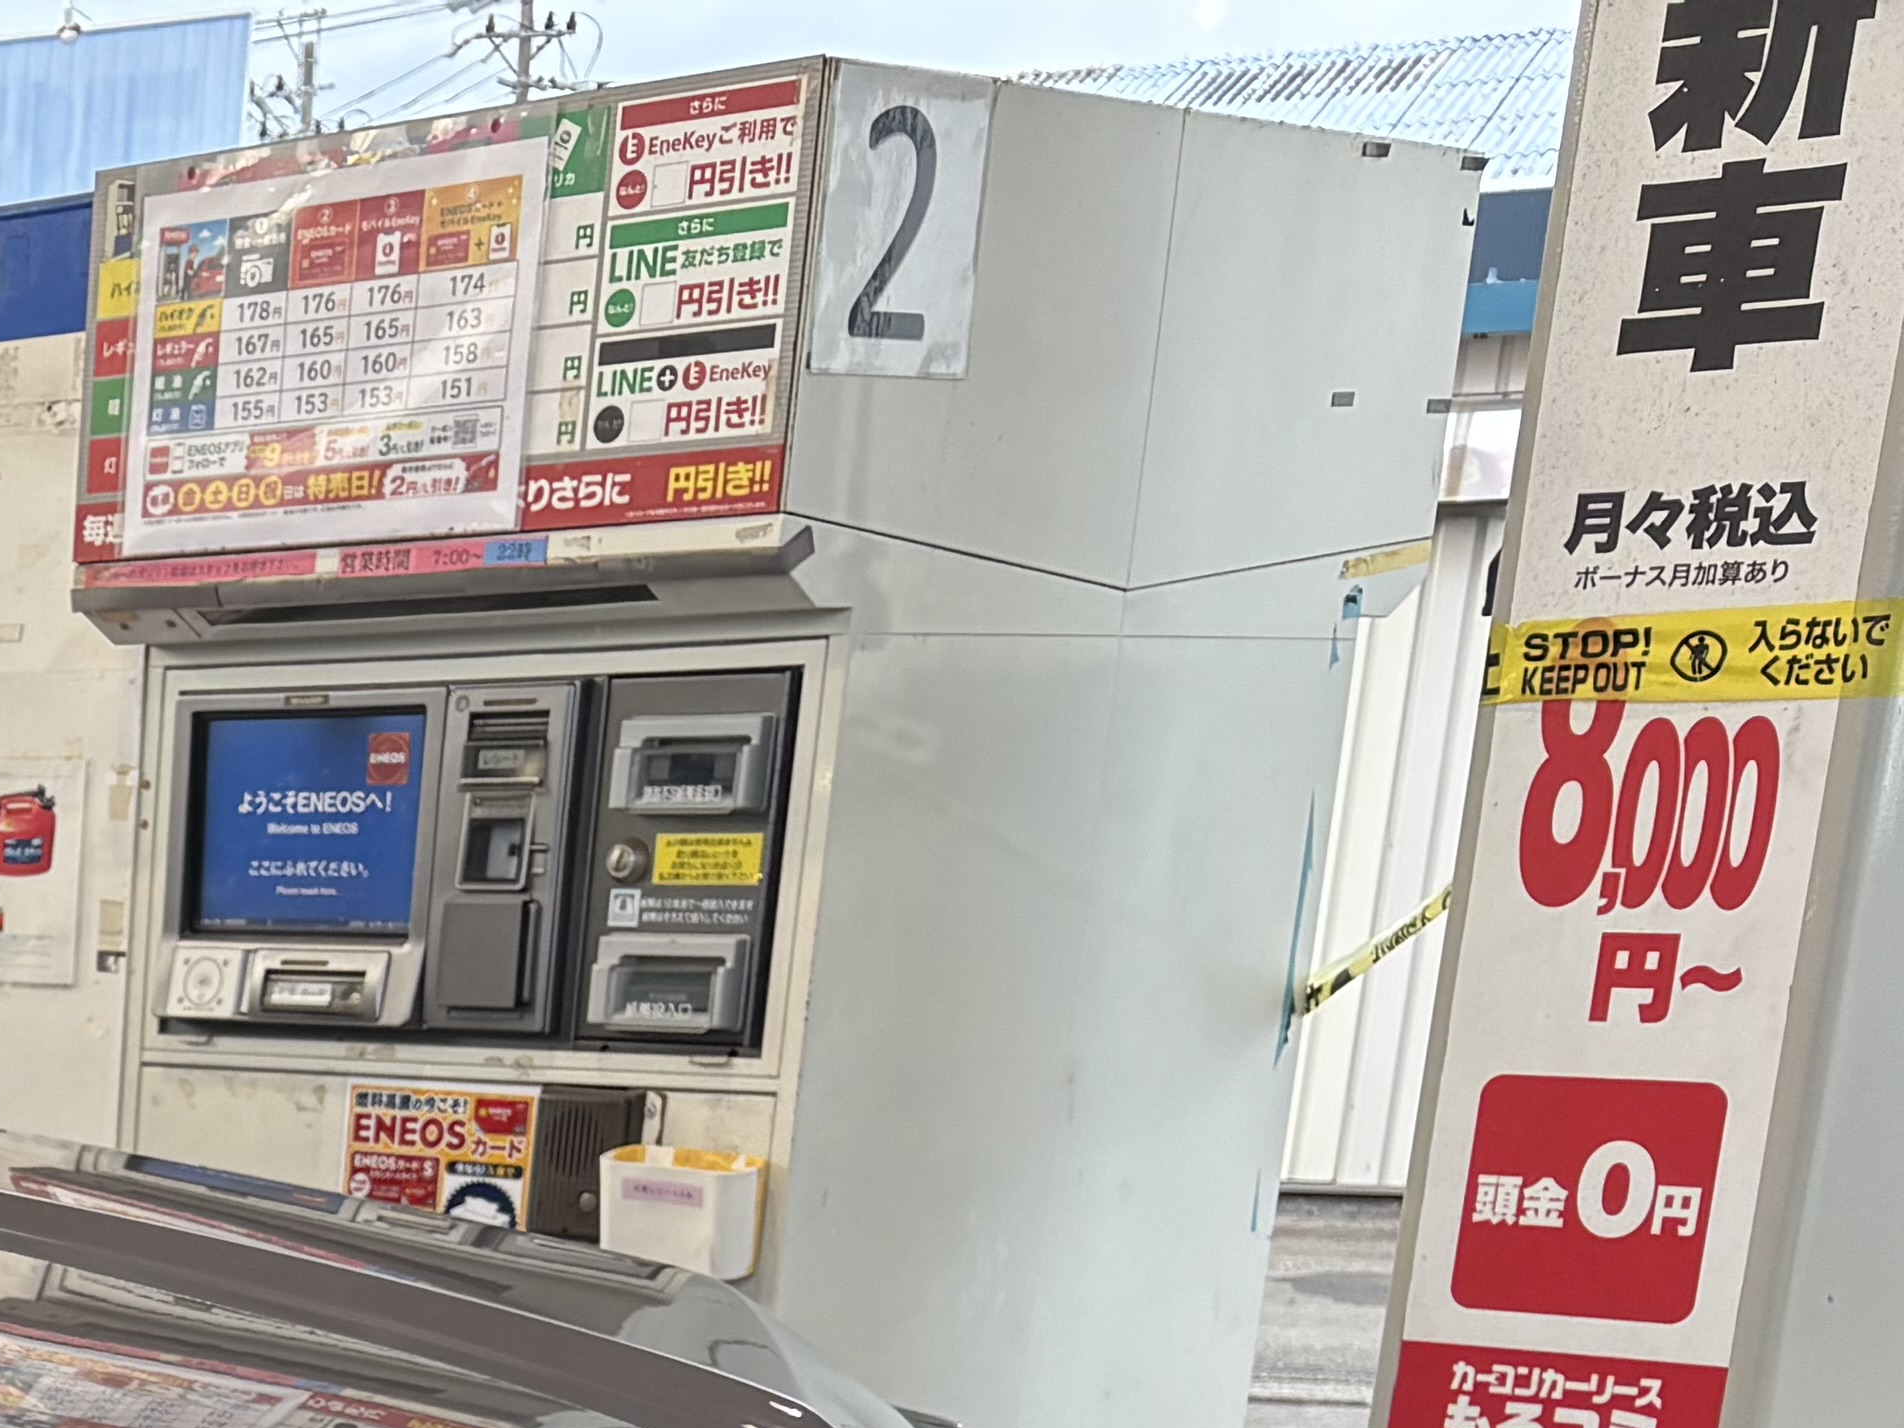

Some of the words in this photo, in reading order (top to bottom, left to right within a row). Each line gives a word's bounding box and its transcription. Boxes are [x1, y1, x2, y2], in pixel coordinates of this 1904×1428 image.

[689, 95, 728, 115] さらに
[687, 151, 793, 200] 円引き!!
[1616, 0, 1880, 373] 新車
[575, 223, 595, 250] 円
[677, 217, 715, 236] さらに
[848, 104, 937, 342] 2
[366, 282, 415, 307] 176円
[568, 289, 589, 316] 円
[676, 274, 781, 320] 円引き!!
[237, 300, 283, 325] 178円
[364, 318, 411, 341] 165円
[235, 333, 281, 357] 167円
[234, 365, 278, 388] 162円
[361, 351, 408, 375] 160円
[562, 355, 583, 382] 円
[596, 365, 655, 398] LINE
[709, 360, 772, 383] EneKey
[231, 399, 276, 421] 155円
[664, 394, 768, 438] 円引き!!
[556, 420, 577, 446] 円
[666, 460, 773, 502] 円引き!!
[1563, 481, 1818, 556] 月々税込
[340, 548, 411, 575] 営業時間
[1572, 557, 1792, 592] ボーナス月加算あり
[1522, 626, 1653, 664] STOP!
[1748, 612, 1892, 654] 入らないで
[1520, 663, 1586, 697] KEEP
[1592, 660, 1649, 695] OUT
[1759, 655, 1870, 689] ください
[1518, 620, 1781, 916] 8,000
[237, 790, 393, 815] ようこそENEOSへ!
[266, 822, 309, 835] Welcome
[352, 1113, 468, 1152] ENEOS
[470, 1134, 524, 1160] カード
[1472, 1139, 1704, 1240] 頭金0円
[1449, 1359, 1664, 1410] カーコンカーリース
